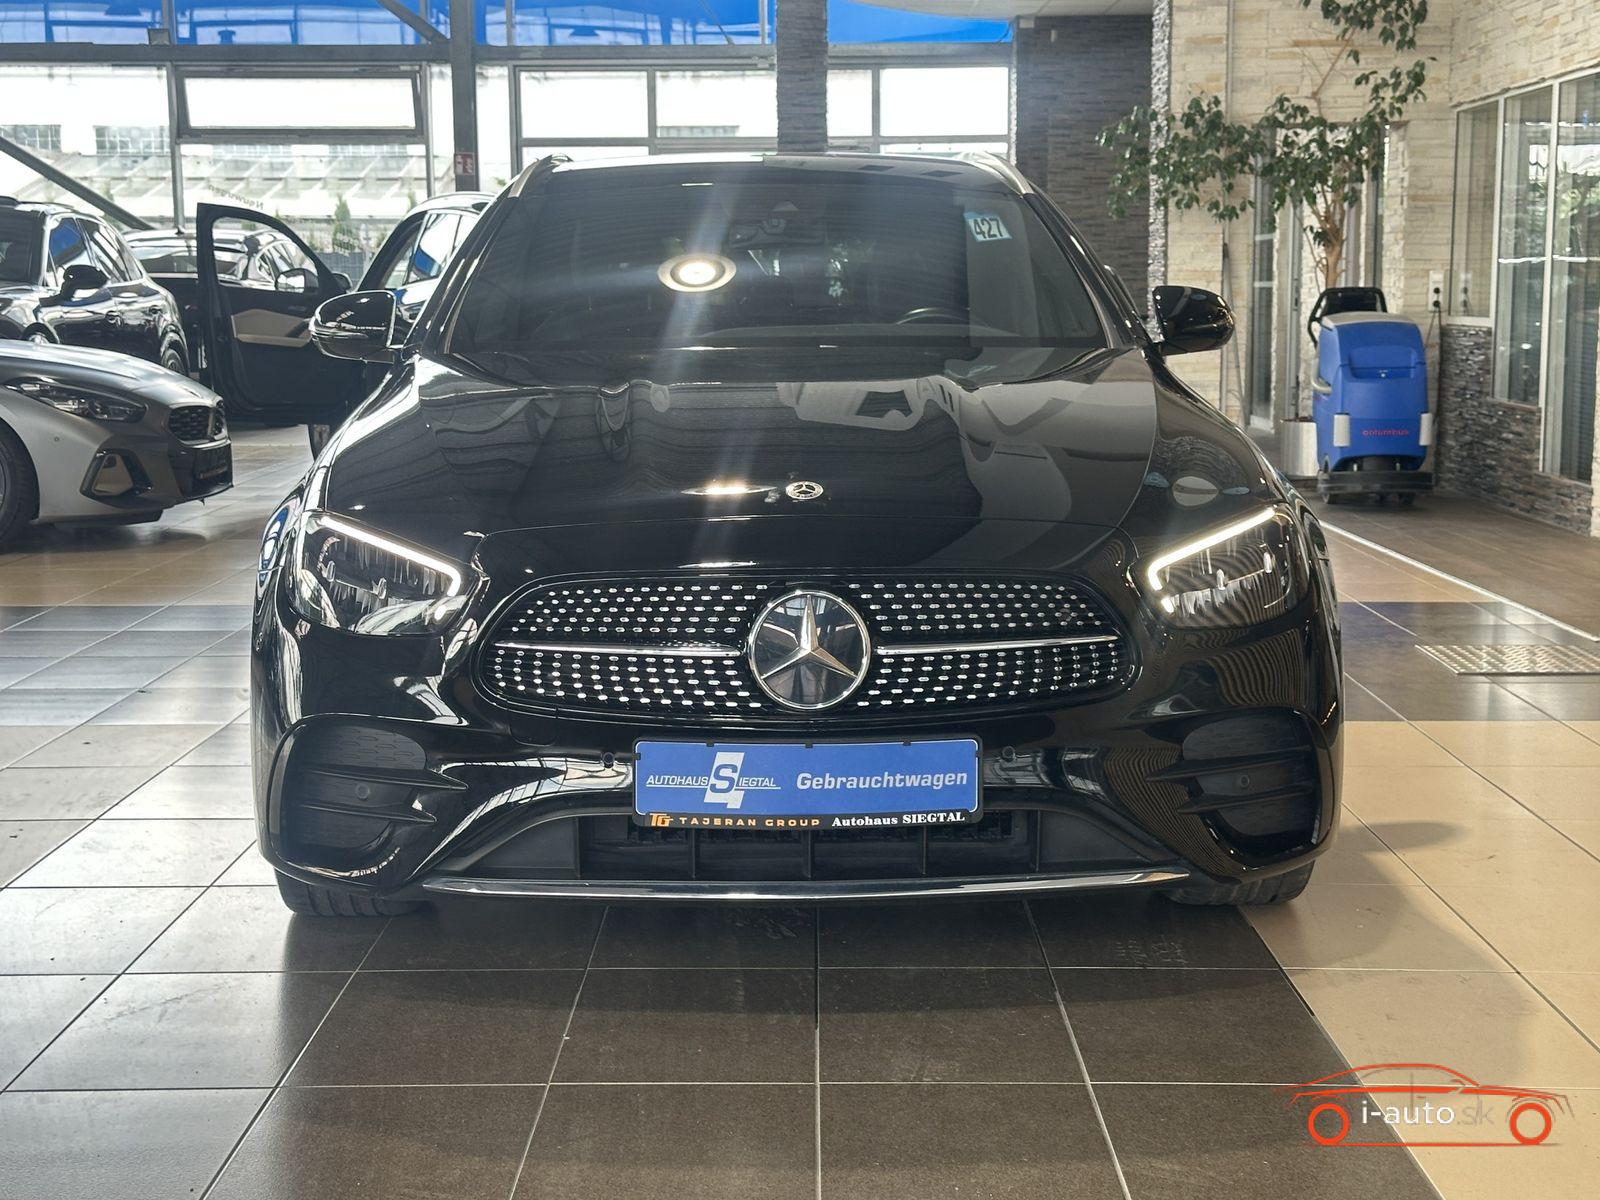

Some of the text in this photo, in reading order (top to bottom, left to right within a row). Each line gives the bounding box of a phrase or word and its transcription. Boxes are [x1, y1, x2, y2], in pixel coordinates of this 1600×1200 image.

[973, 218, 1003, 239] 427
[646, 775, 709, 786] AUTOHAUS
[796, 771, 968, 791] Gebrauchtwagen
[679, 817, 757, 827] TAJERAN
[765, 818, 820, 828] GROUP
[831, 812, 965, 828] Autohaus SIEGTAL
